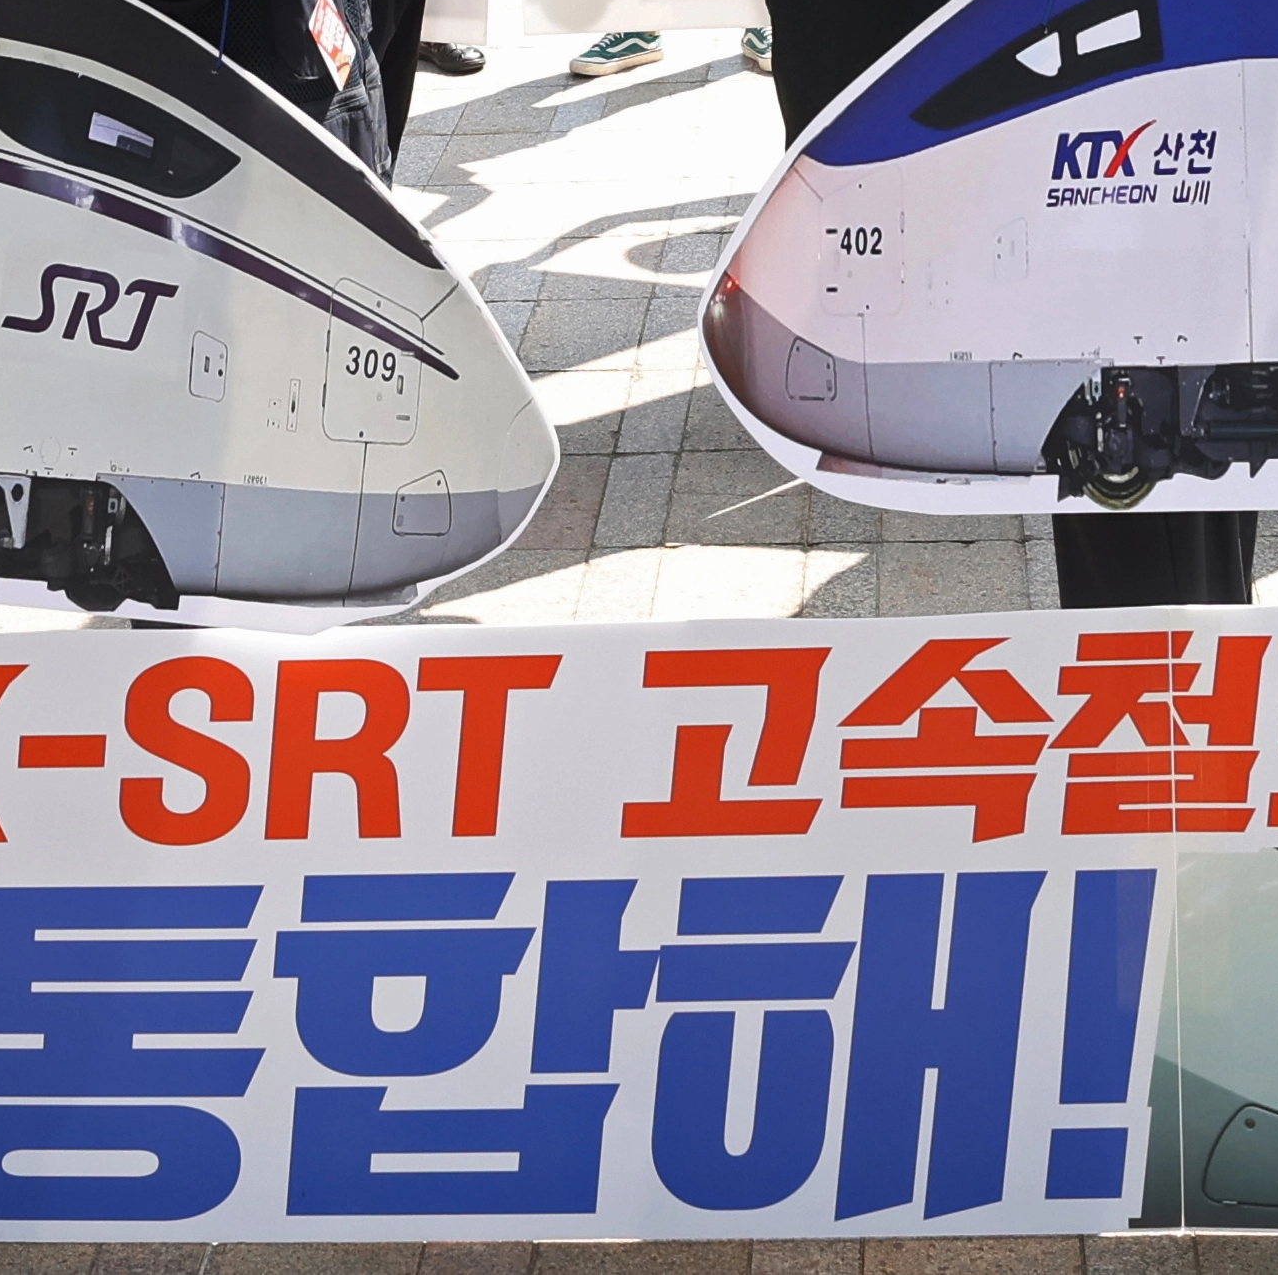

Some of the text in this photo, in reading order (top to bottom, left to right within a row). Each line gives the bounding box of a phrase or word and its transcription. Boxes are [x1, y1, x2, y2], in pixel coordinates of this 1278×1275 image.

[1052, 119, 1217, 181] KTX 산천
[1045, 181, 1211, 209] SANCHEON 山川
[839, 226, 884, 257] 402
[1, 262, 180, 352] SRT
[345, 345, 398, 383] 309
